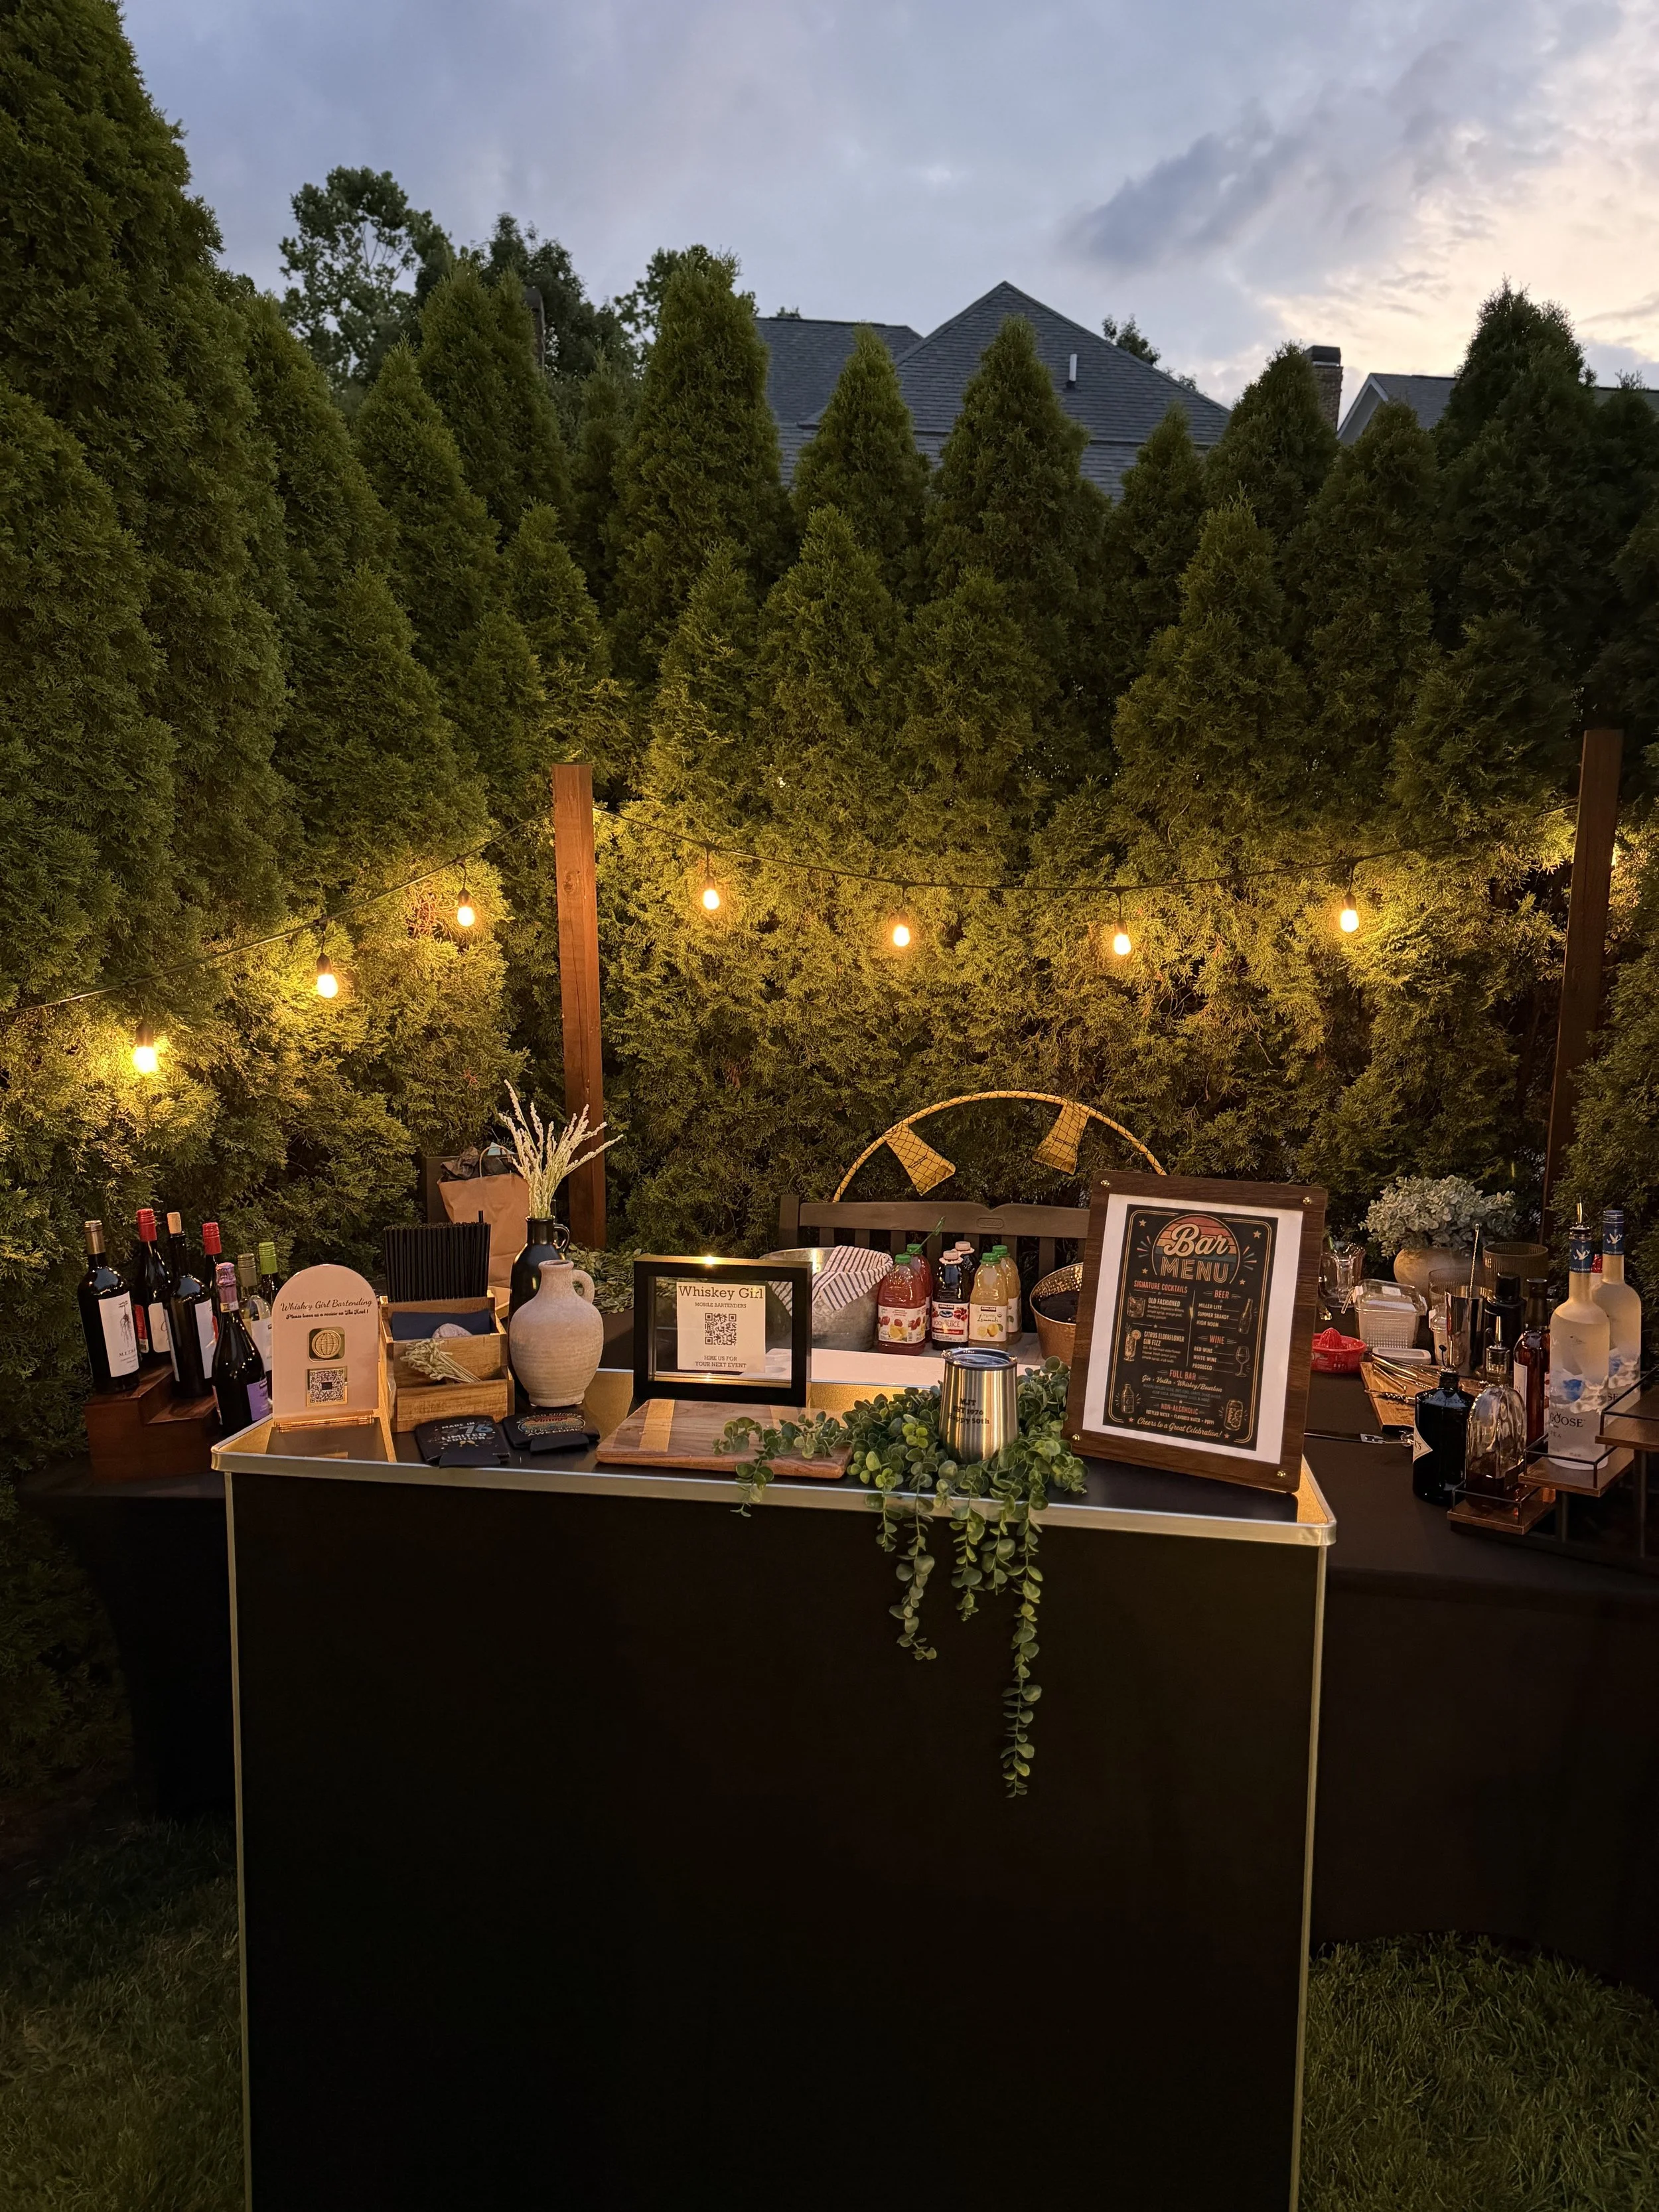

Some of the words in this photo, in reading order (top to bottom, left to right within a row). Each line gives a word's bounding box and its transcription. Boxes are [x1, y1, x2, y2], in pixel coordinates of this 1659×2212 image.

[1163, 1223, 1229, 1257] Bar
[1161, 1257, 1229, 1283] MENU
[1134, 1280, 1160, 1290] SIGNATURE
[1162, 1284, 1188, 1293] COCKTAILS
[678, 1286, 735, 1300] Whiskey
[739, 1288, 763, 1298] Girl
[1214, 1290, 1230, 1299] BEER
[281, 1301, 312, 1311] Whiskey
[315, 1300, 330, 1309] Girl
[332, 1298, 372, 1308] Bartending
[1157, 1298, 1180, 1307] FASHIONED
[1159, 1333, 1185, 1342] ELDERFLOWER
[1210, 1335, 1225, 1344] WINE
[1169, 1370, 1183, 1378] FULL
[1185, 1371, 1196, 1380] BAR
[1161, 1403, 1198, 1415] NON-ALCOHOLIC
[948, 1413, 970, 1424] Happy
[1550, 1414, 1583, 1428] GOOSE
[1137, 1417, 1156, 1426] Cheers
[1169, 1423, 1185, 1432] Great
[1187, 1426, 1222, 1438] Celebration!
